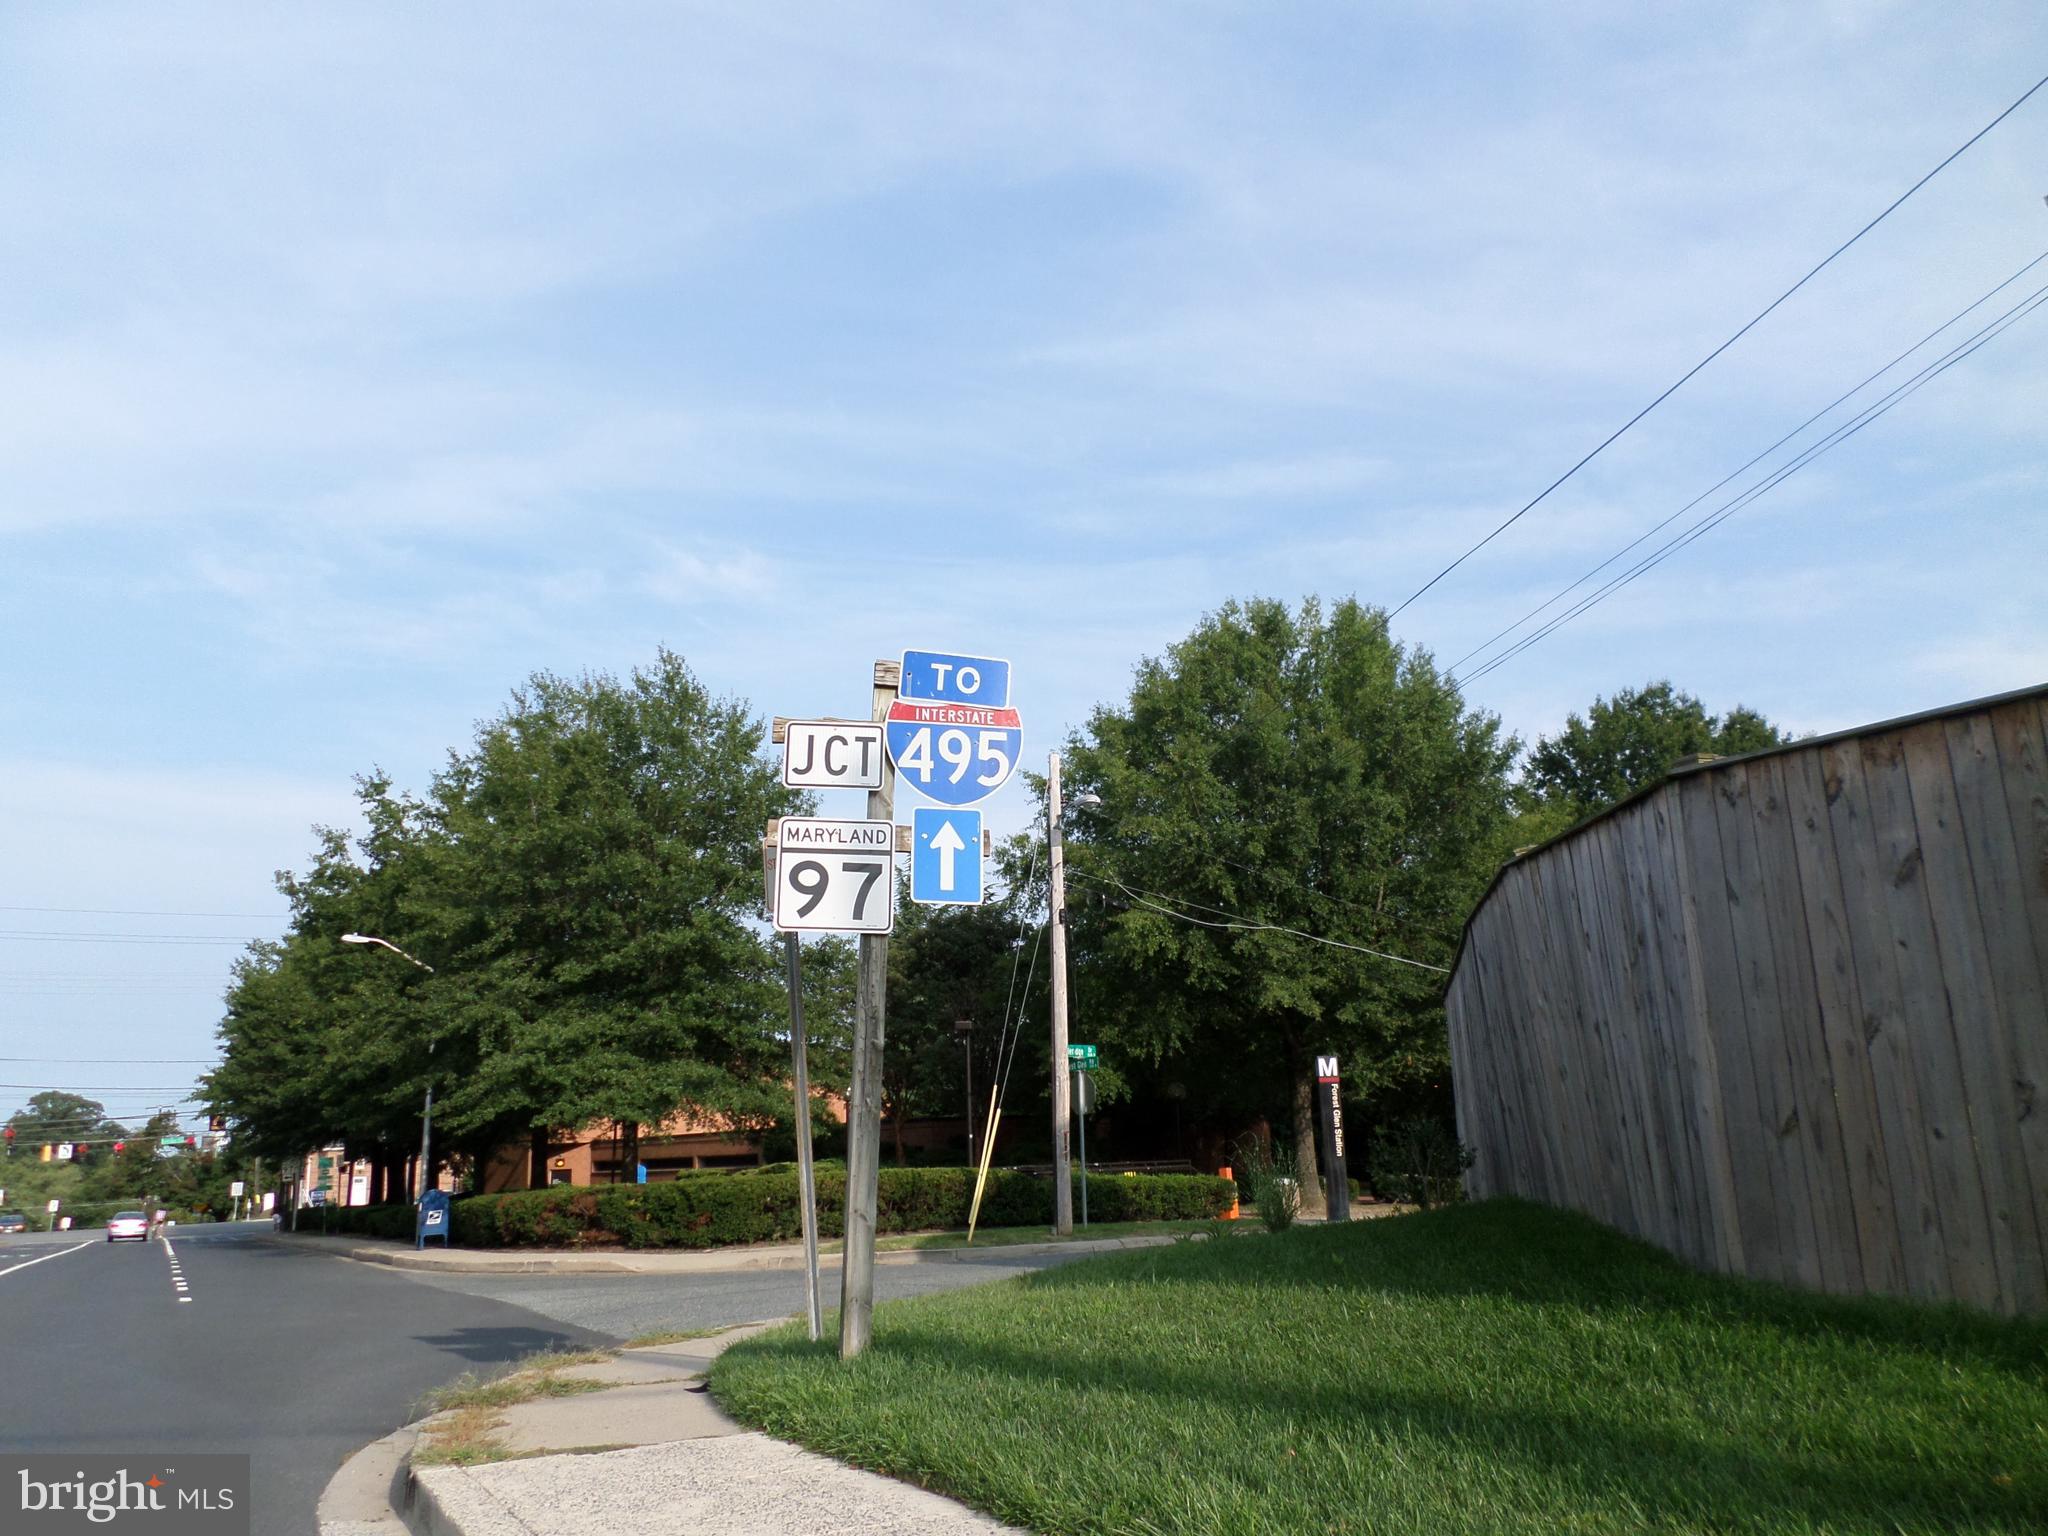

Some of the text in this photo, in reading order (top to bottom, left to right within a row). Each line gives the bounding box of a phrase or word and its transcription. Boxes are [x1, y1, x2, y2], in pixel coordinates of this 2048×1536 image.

[931, 663, 980, 694] TO
[915, 707, 995, 725] INTERSTATE
[792, 734, 877, 777] JCT
[898, 727, 1010, 787] 495
[787, 827, 887, 844] MARYLAND
[788, 860, 883, 921] 97
[1317, 1057, 1339, 1077] M
[1331, 1083, 1343, 1157] Forest Glen Station
